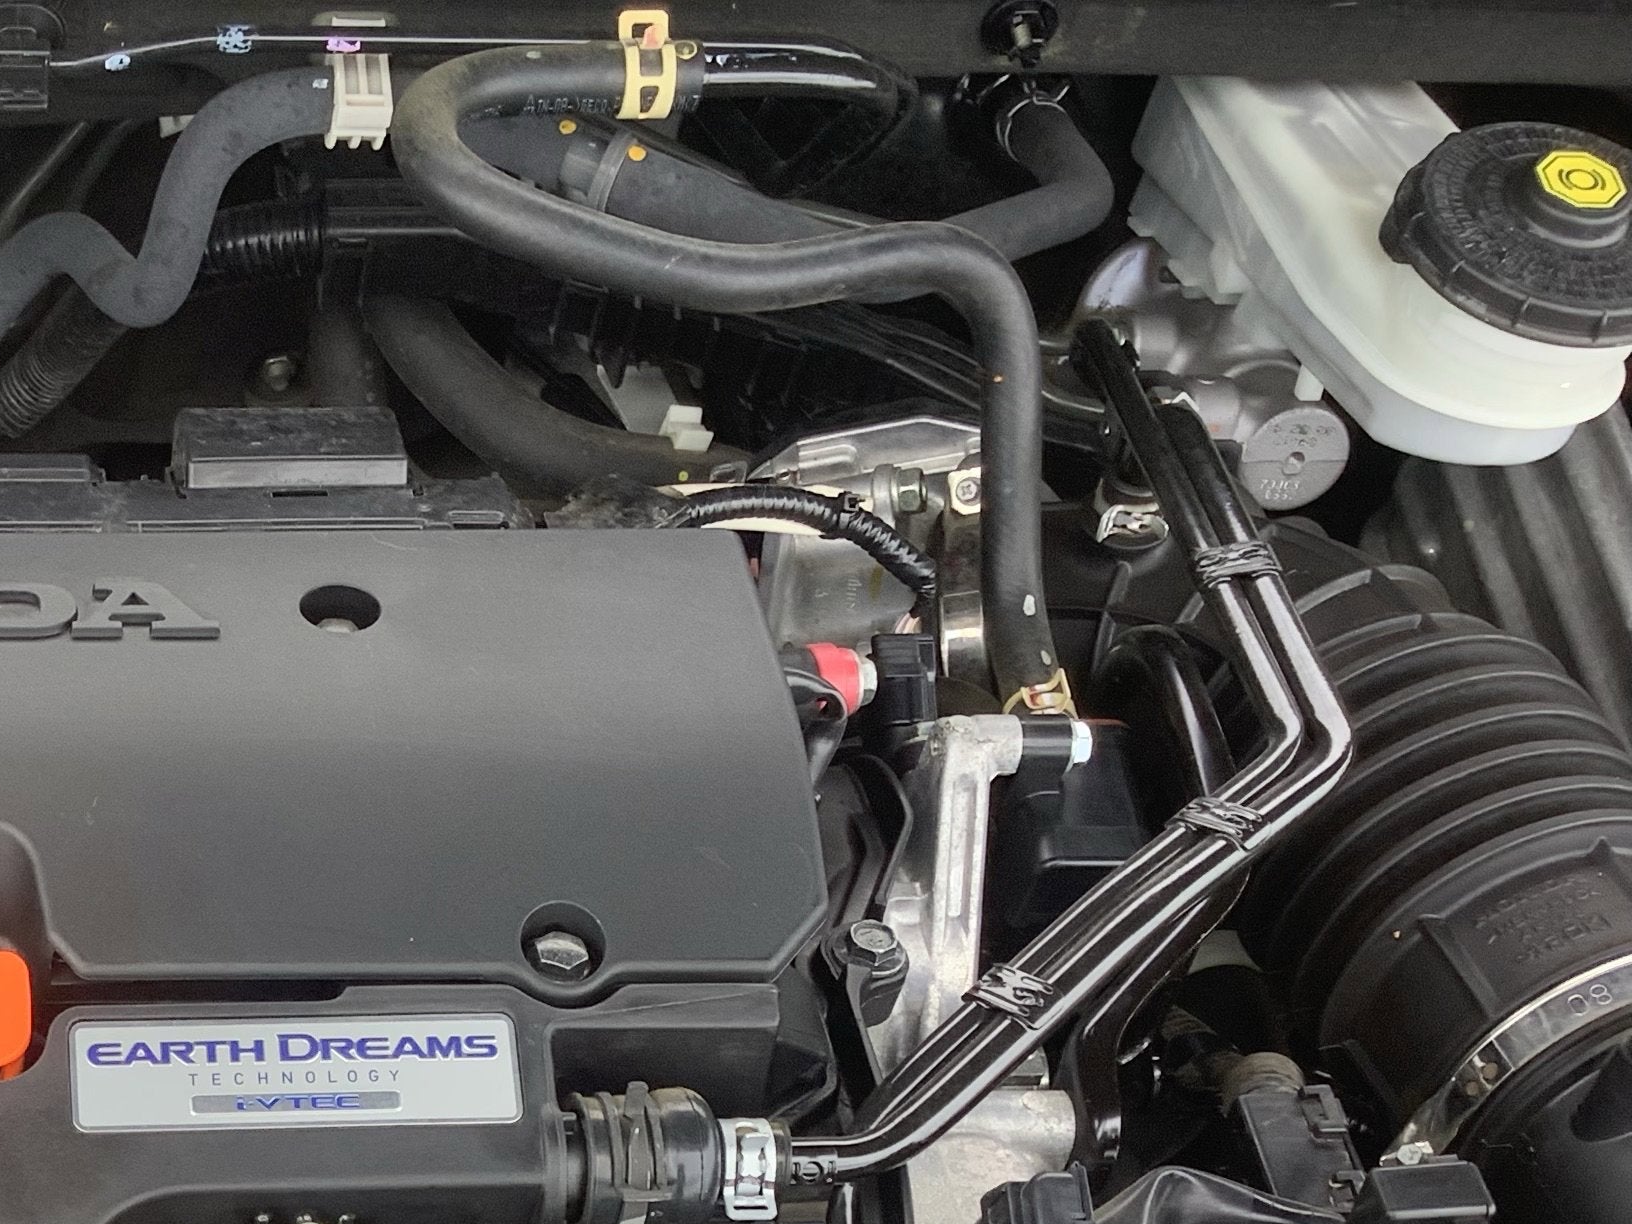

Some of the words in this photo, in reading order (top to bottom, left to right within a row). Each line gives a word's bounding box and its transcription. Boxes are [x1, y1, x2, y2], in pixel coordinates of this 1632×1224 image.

[86, 1039, 265, 1067] EARTH
[278, 1033, 499, 1063] DREAMS
[188, 1069, 401, 1087] TECHNOLOGY
